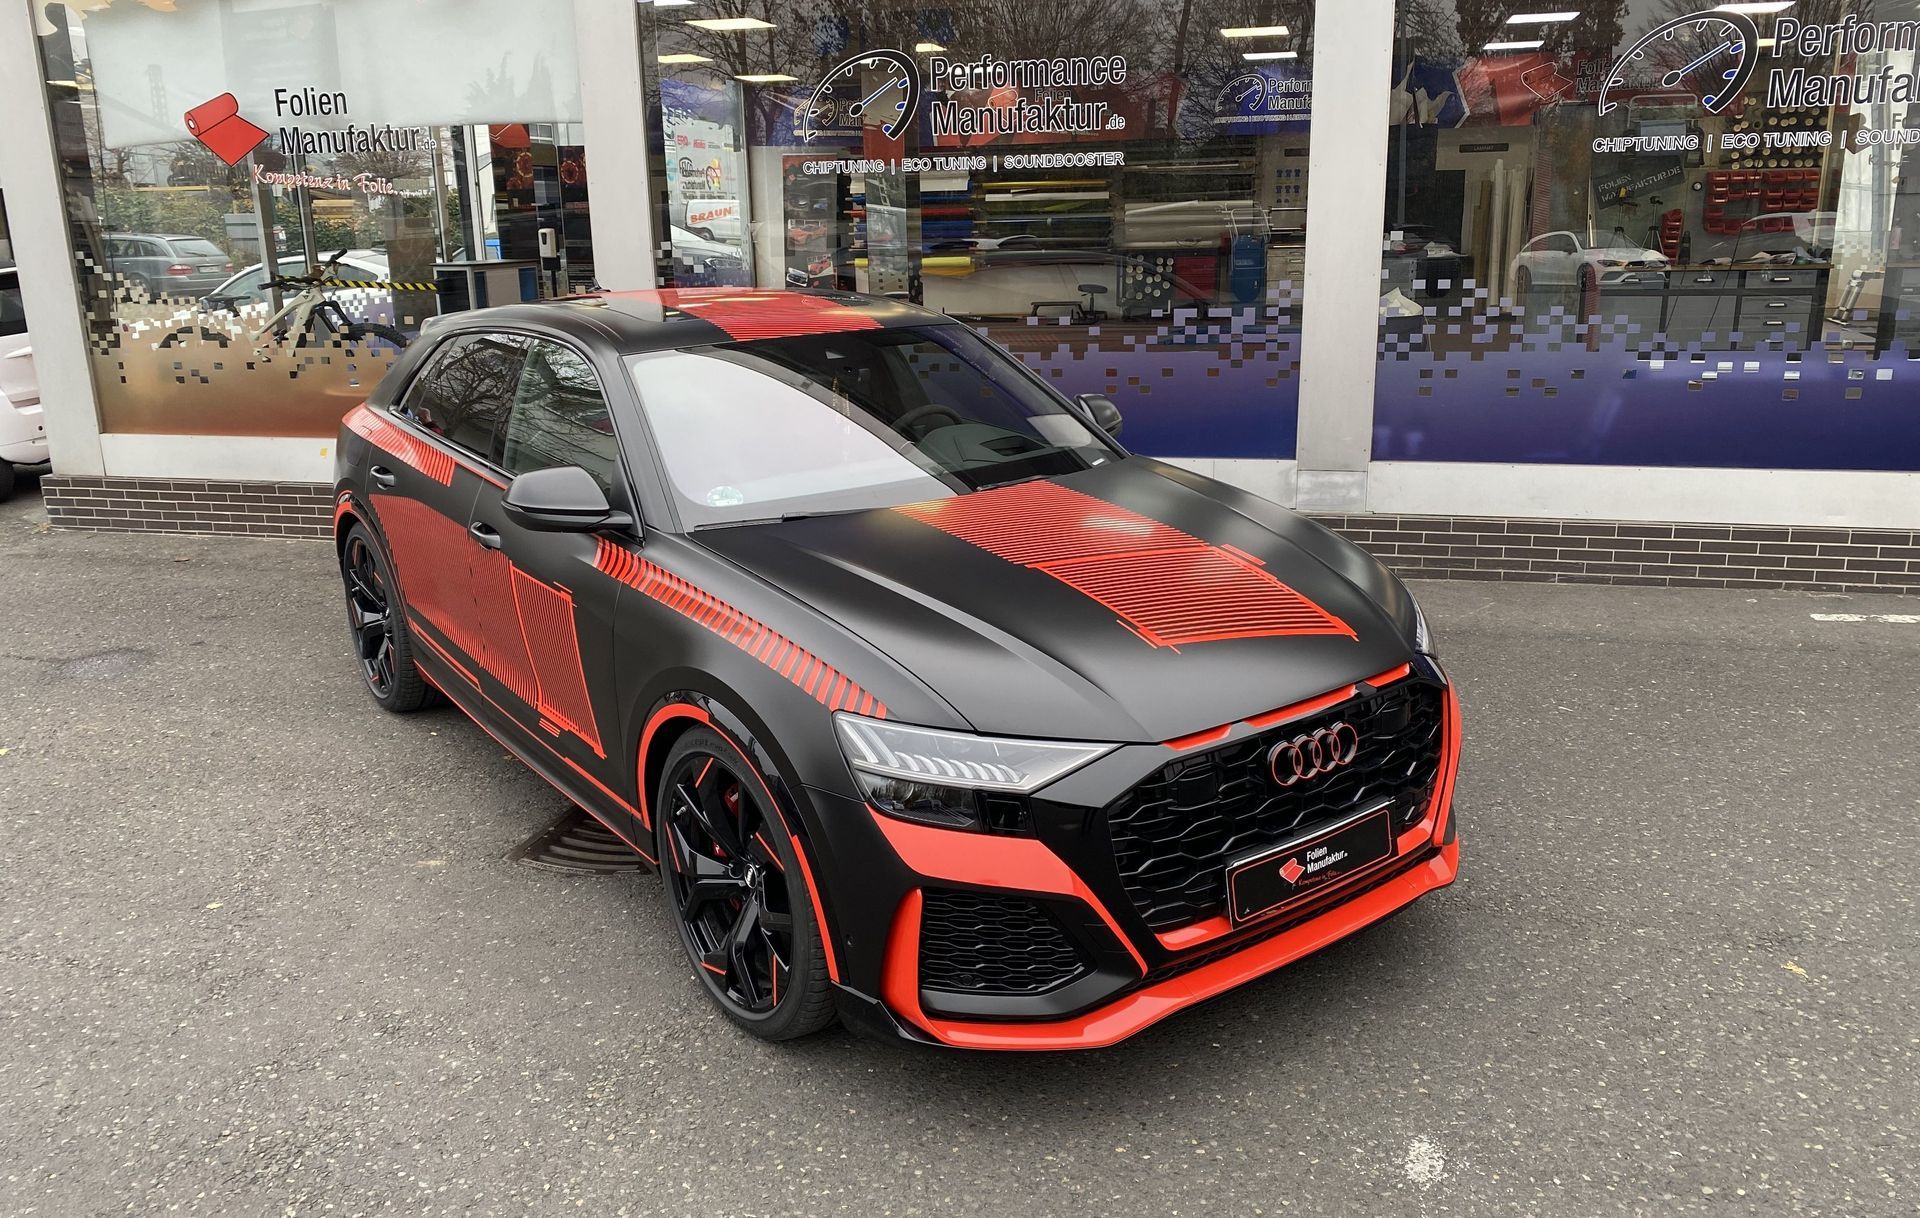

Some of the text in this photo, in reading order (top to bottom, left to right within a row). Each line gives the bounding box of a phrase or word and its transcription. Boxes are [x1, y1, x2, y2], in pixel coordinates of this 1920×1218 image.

[929, 53, 1127, 92] Performance
[273, 86, 348, 117] Folien
[931, 97, 1126, 136] Manufaktur.de
[1592, 134, 1699, 153] CHIPTUNING
[1721, 132, 1761, 149] ECO
[1763, 131, 1833, 148] TUNING
[802, 158, 885, 175] CHIPTUNING
[901, 158, 932, 172] ECO
[933, 156, 987, 171] TUNING
[1003, 151, 1125, 170] SOUNDBOOSTER
[336, 173, 351, 190] in
[691, 207, 732, 223] BRAUN
[1307, 846, 1328, 862] Folien
